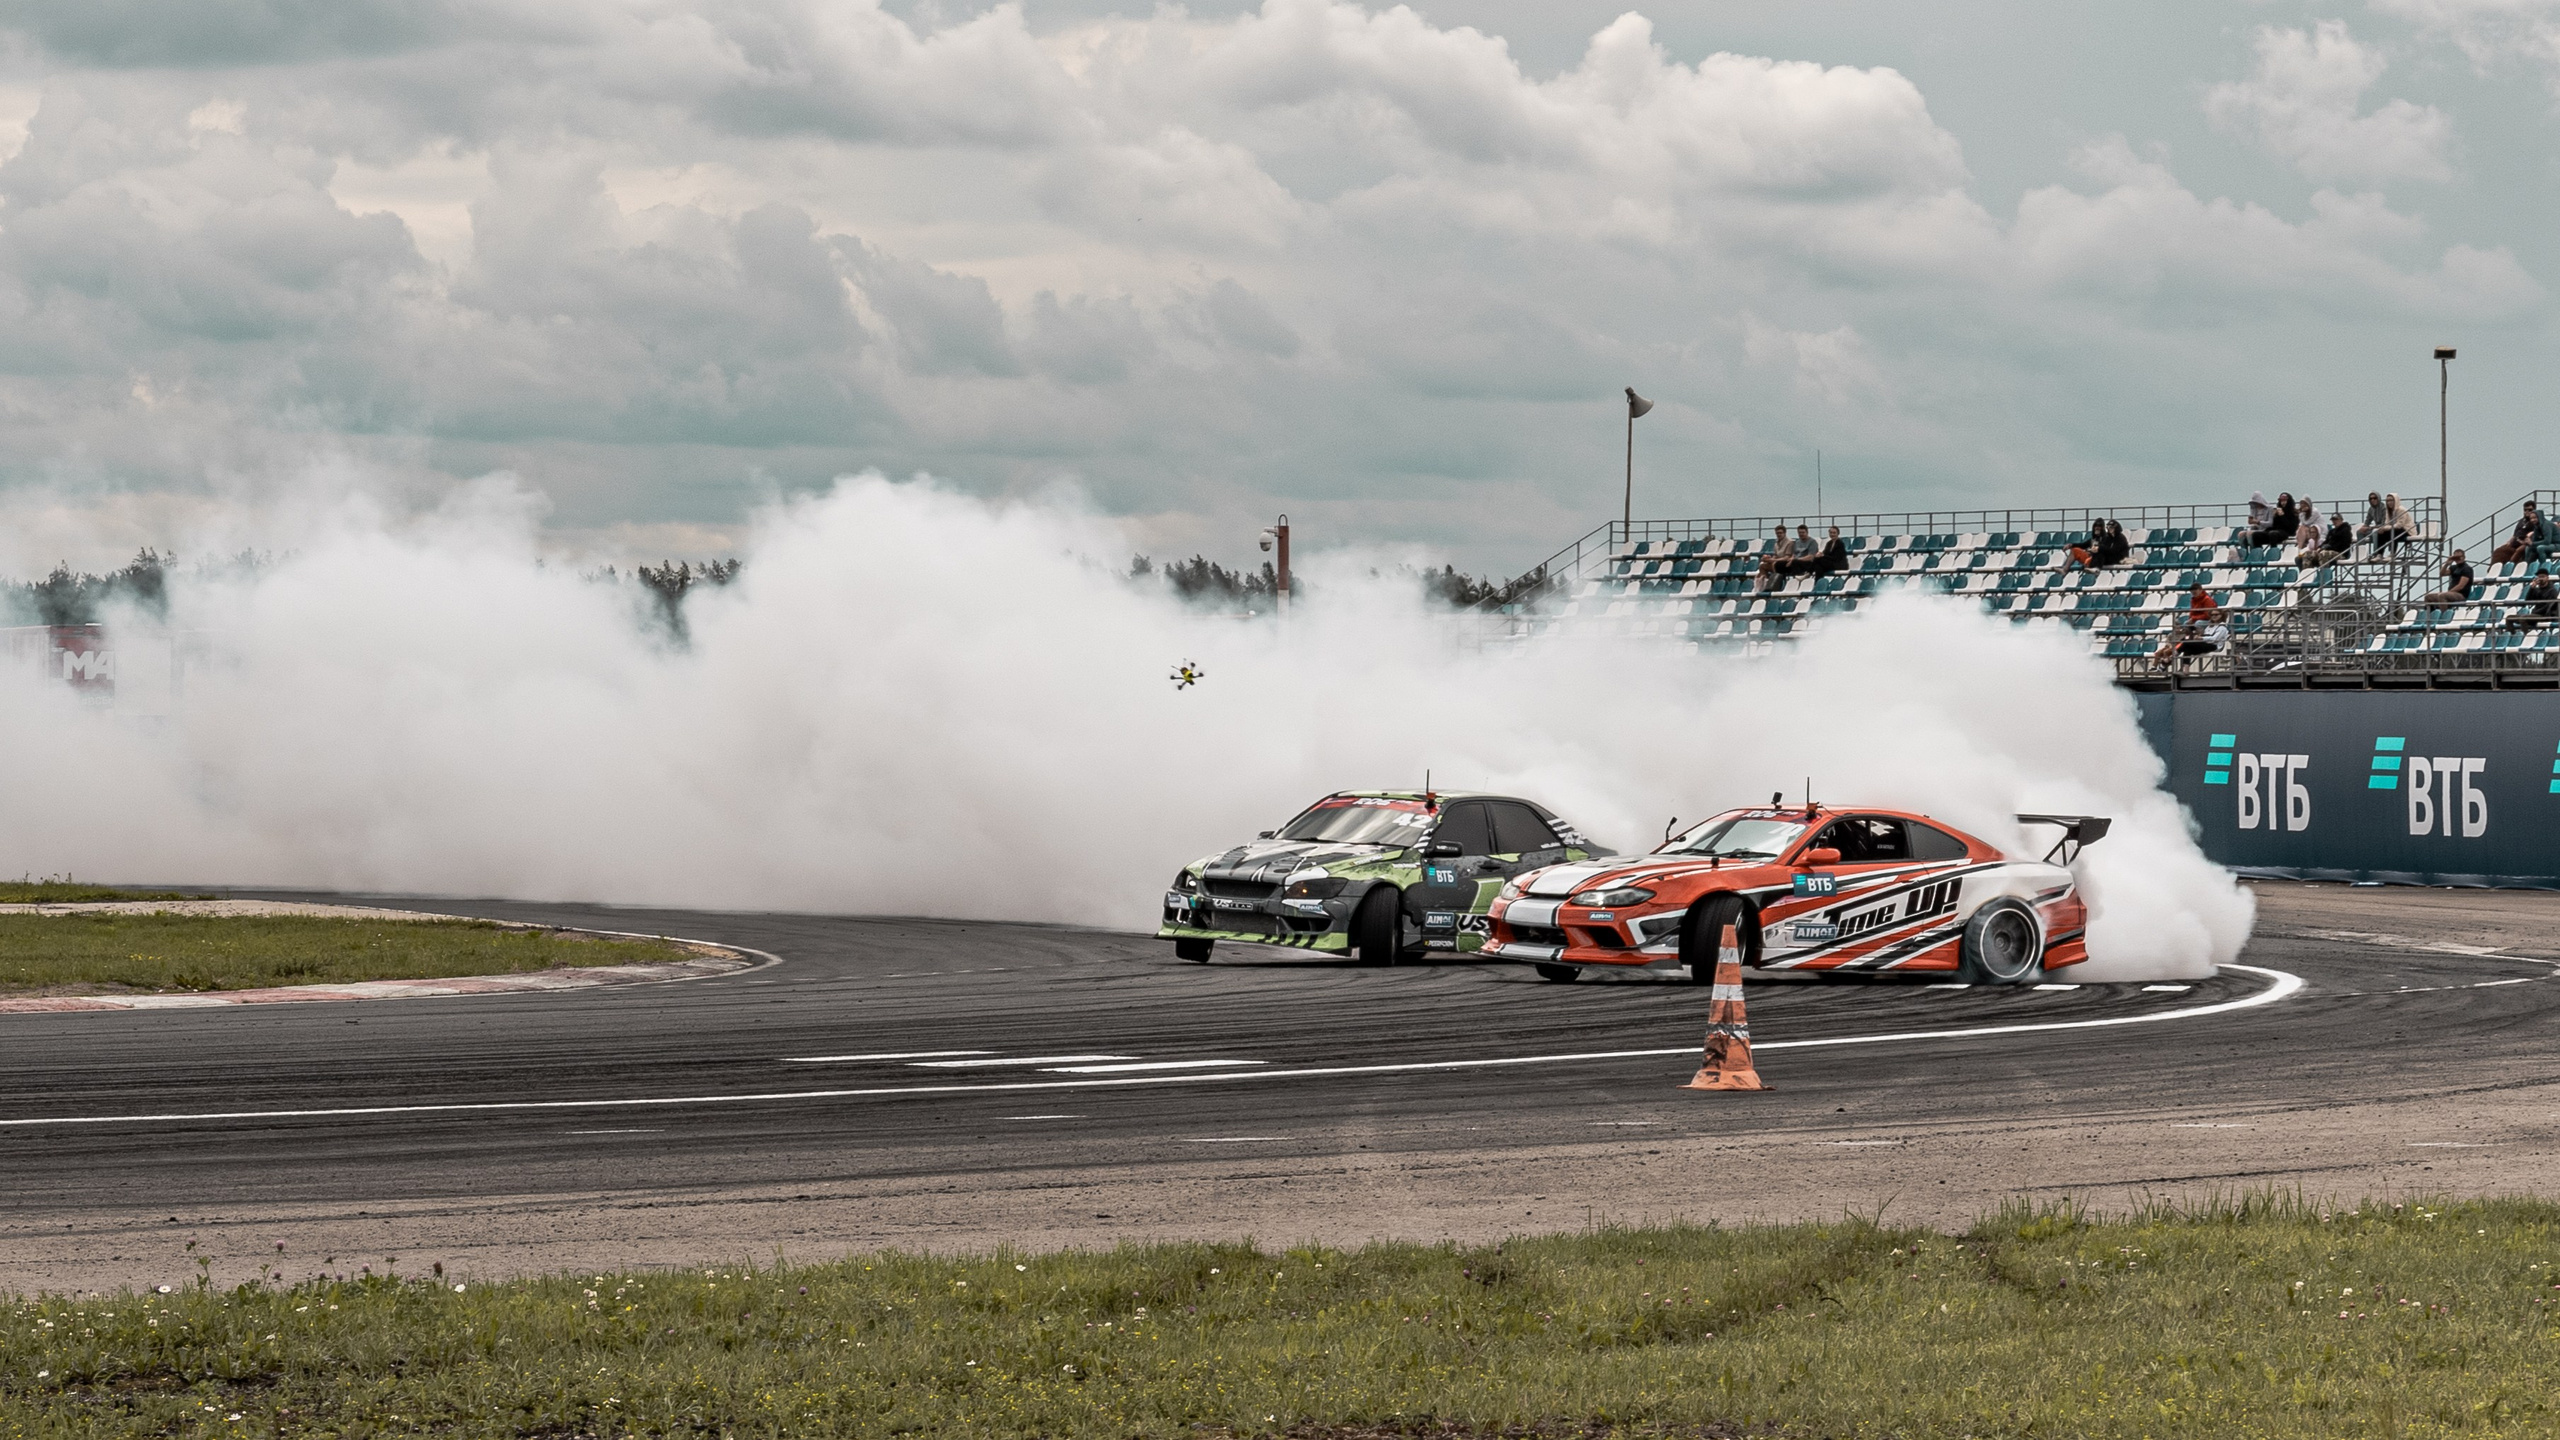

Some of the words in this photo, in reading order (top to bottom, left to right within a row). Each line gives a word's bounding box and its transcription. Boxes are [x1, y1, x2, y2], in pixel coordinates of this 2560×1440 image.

[2238, 753, 2311, 831] ВТБ
[2408, 756, 2488, 837] ВТБ
[1392, 813, 1433, 829] 42
[1436, 870, 1454, 883] ВТБ
[1807, 877, 1832, 892] ВТБ
[1797, 925, 1836, 937] AIMOL
